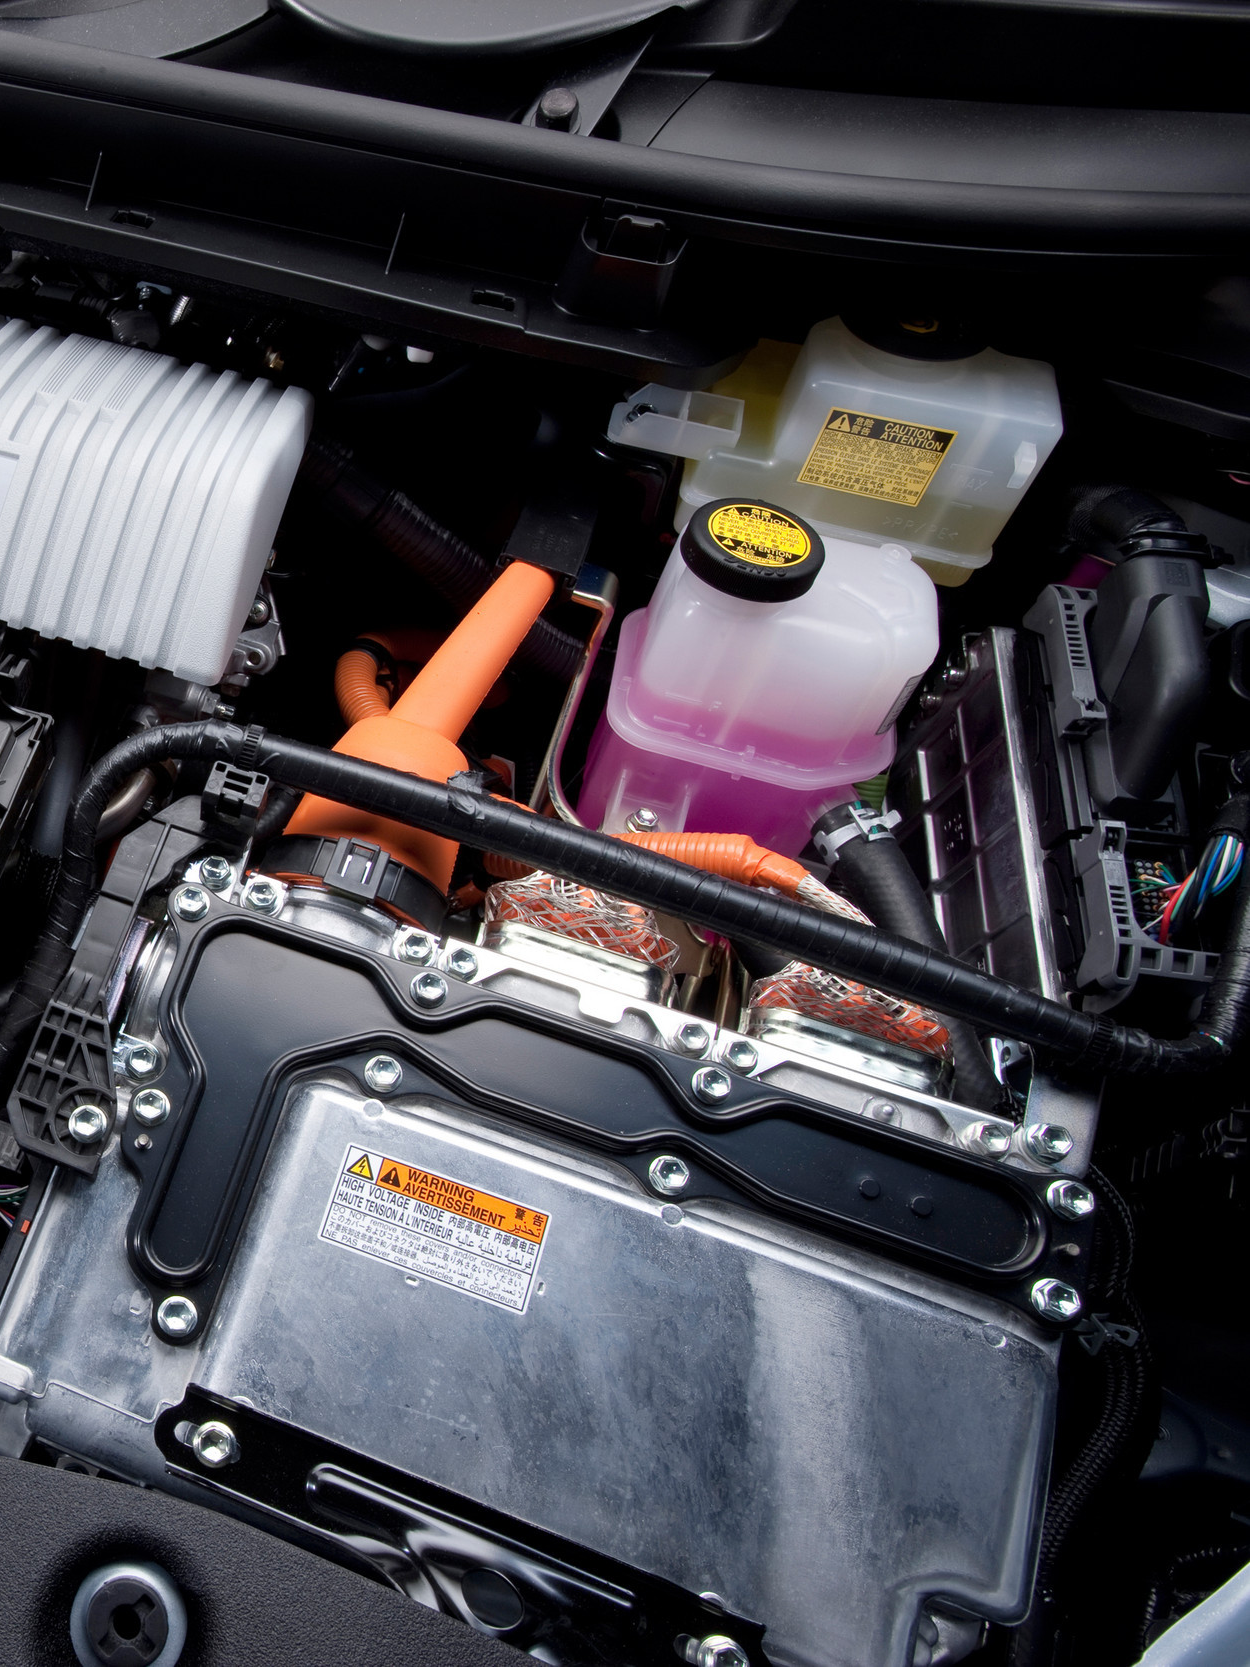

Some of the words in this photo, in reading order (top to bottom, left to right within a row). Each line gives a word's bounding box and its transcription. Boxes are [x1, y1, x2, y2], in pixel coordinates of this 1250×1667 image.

[879, 430, 944, 451] ATTENTION
[883, 422, 935, 440] CAUTION
[741, 511, 788, 526] CAUTION
[740, 541, 792, 558] ATTENTION
[341, 1175, 365, 1193] HIGH
[367, 1185, 410, 1210] VOLTAGE
[413, 1201, 445, 1222] INSIDE
[401, 1180, 505, 1227] AVERTISSEMENT
[406, 1168, 475, 1202] WARNING
[336, 1189, 363, 1208] HAUTE
[363, 1199, 398, 1220] TENSION
[397, 1208, 406, 1223] À
[405, 1211, 454, 1241] L'INTÉRIEUR
[324, 1229, 337, 1238] NE
[340, 1235, 358, 1246] PAS
[361, 1242, 390, 1258] enlever
[393, 1254, 408, 1265] ces
[411, 1261, 453, 1282] couvercles
[457, 1278, 465, 1286] et
[332, 1204, 346, 1214] DO
[349, 1210, 366, 1222] NOT
[369, 1217, 397, 1233] remove
[400, 1229, 421, 1242] these
[424, 1238, 449, 1252] covers
[452, 1248, 477, 1263] and/or
[480, 1258, 524, 1280] connectors.
